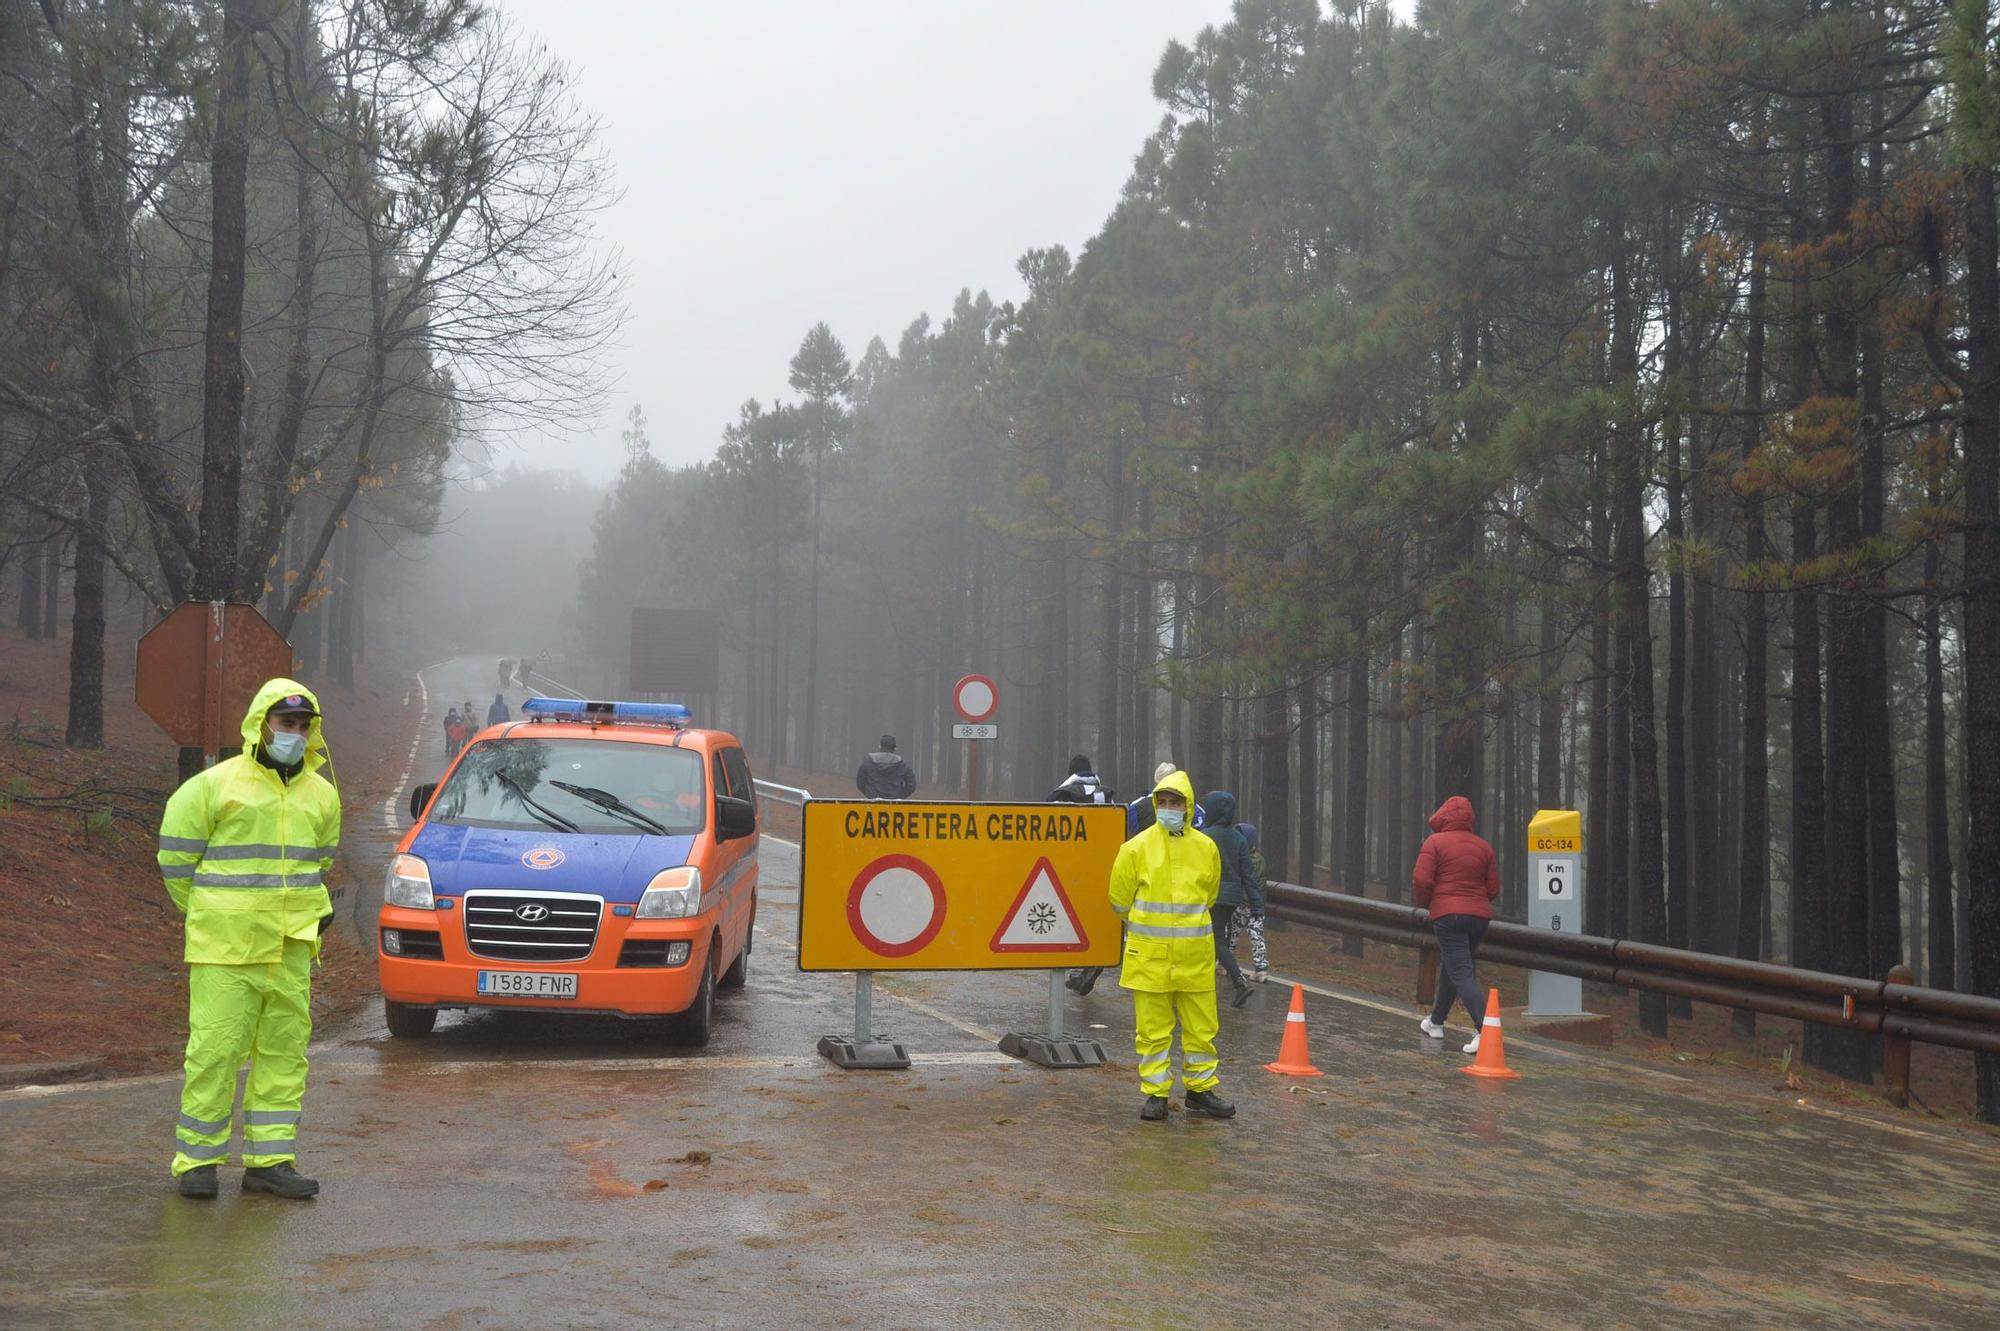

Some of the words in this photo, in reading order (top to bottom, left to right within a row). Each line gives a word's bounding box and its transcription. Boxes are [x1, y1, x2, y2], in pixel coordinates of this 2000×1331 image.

[844, 810, 979, 840] CARRETERA
[986, 813, 1088, 841] CERRADA
[1537, 839, 1573, 850] GC-134
[1546, 863, 1565, 873] Km
[1548, 877, 1563, 895] 0
[491, 974, 534, 991] 1583
[539, 976, 573, 993] FNR
